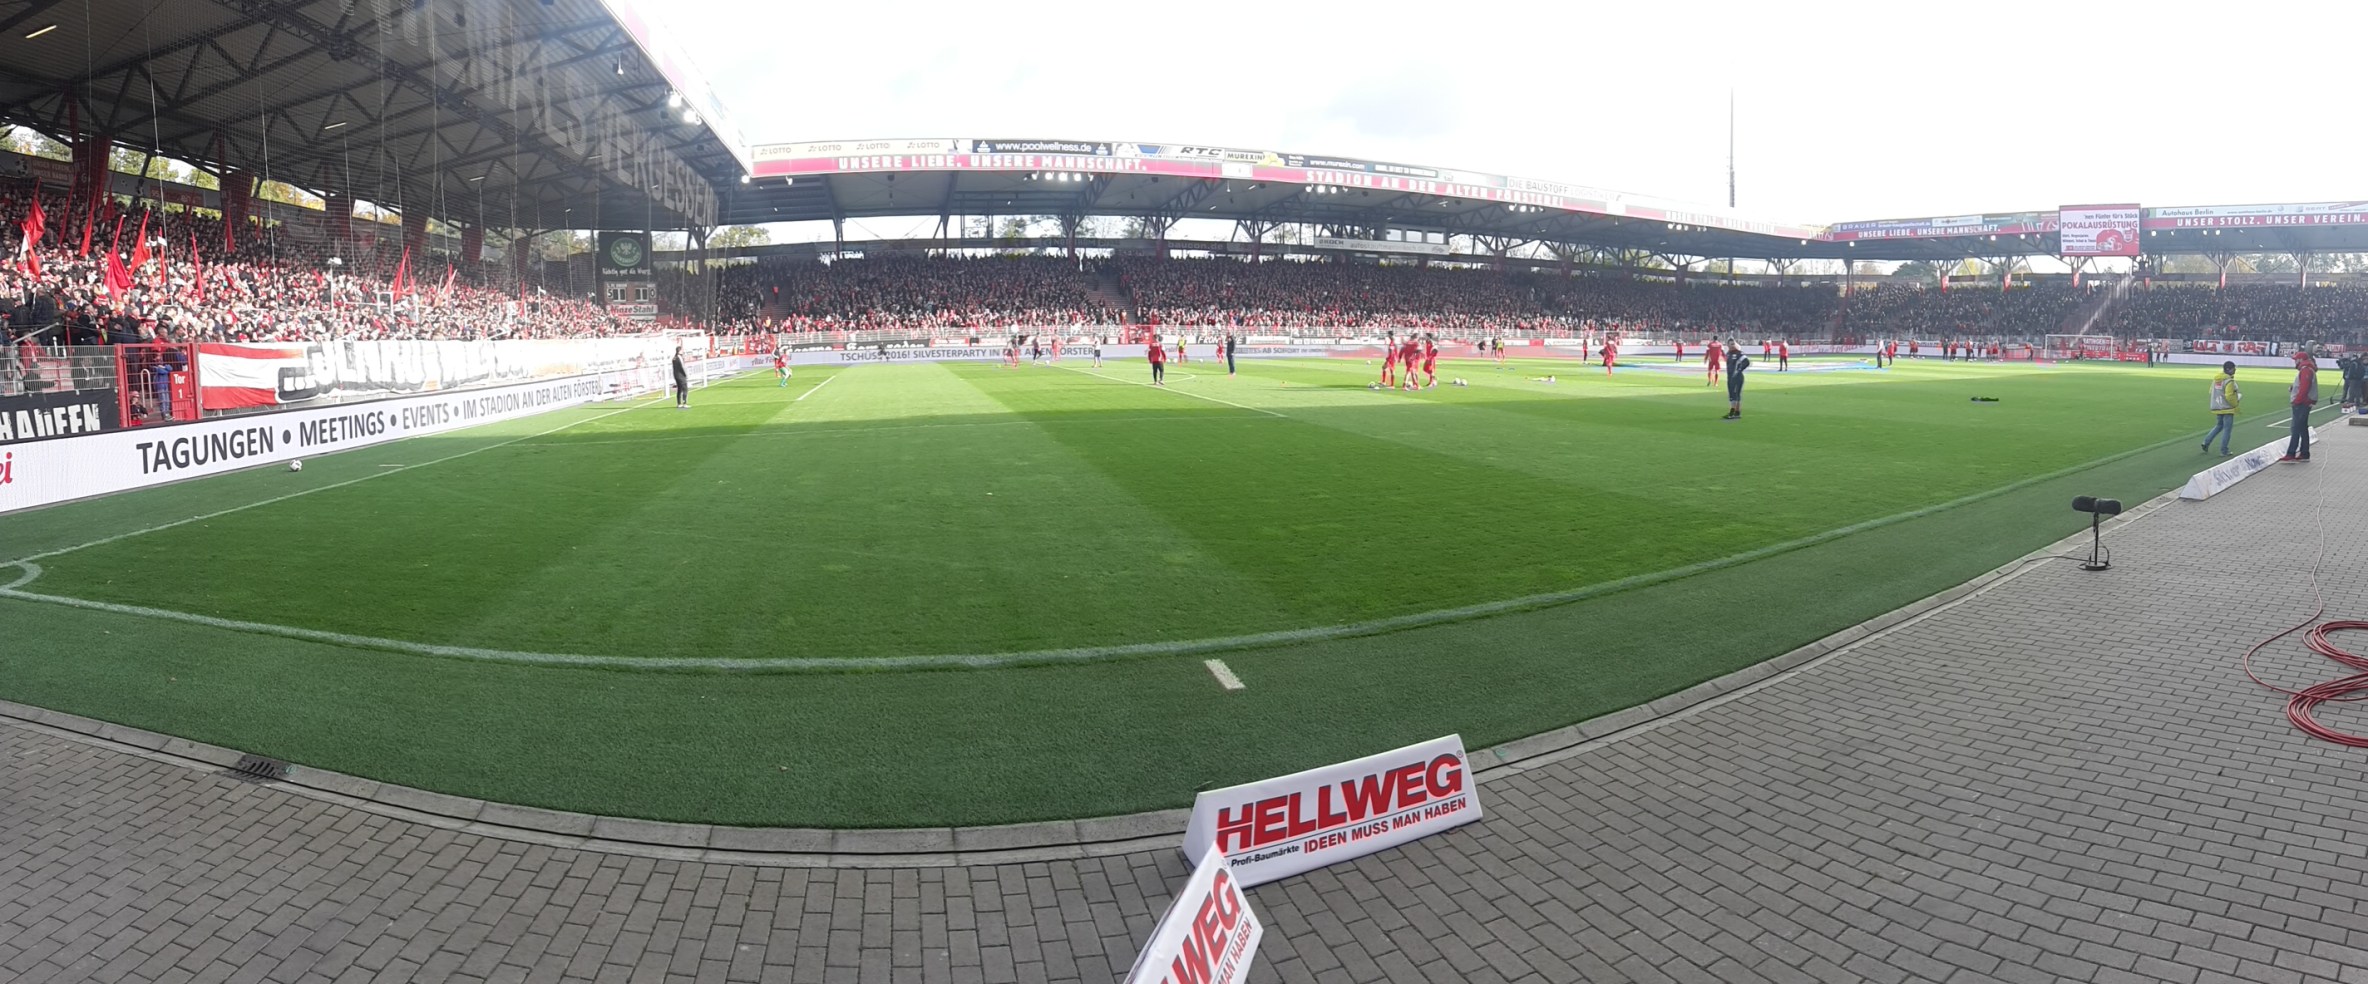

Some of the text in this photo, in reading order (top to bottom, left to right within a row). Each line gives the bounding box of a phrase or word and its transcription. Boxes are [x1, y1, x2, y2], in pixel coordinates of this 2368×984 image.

[866, 142, 890, 150] LOTTO
[995, 142, 1092, 153] www.poolwellness.de
[1181, 146, 1222, 156] RTC
[1227, 152, 1265, 161] MUREXIN
[839, 155, 902, 170] UNSERE
[970, 155, 1034, 168] UNSERE
[1042, 155, 1148, 171] MANNSCHAFT.
[1307, 170, 1372, 187] STADION
[1381, 177, 1401, 189] AN
[1409, 179, 1436, 193] DER
[1446, 184, 1488, 199] ALTEN
[1496, 188, 1564, 207] FÖRSTEREI
[1509, 178, 1523, 189] DIE
[1526, 180, 1569, 195] BAUSTOFF
[2162, 208, 2214, 217] Autohaus Berlin
[1842, 222, 1877, 231] BRAUER
[2062, 219, 2138, 230] POKALAUSRÜSTUNG
[2177, 218, 2214, 227] UNSER
[2266, 215, 2306, 224] UNSER
[1858, 229, 1886, 239] UNSERE
[1917, 227, 1945, 236] UNSERE
[913, 348, 986, 360] SILVESTERPARTY
[989, 349, 999, 358] IN
[174, 373, 185, 385] Tor
[178, 389, 183, 399] 1
[136, 426, 274, 475] TAGUNGEN
[299, 410, 385, 447] MEETINGS
[402, 402, 450, 430] EVENTS
[463, 398, 477, 420] IM
[480, 392, 520, 416] STADION
[522, 390, 534, 407] AN
[536, 388, 551, 406] DER
[552, 383, 572, 403] ALTEN
[1215, 753, 1463, 853] HELLWEG
[1304, 797, 1467, 854] IDEEN MUSS MAN HABEN
[1231, 844, 1300, 868] Profi-Baumärkte
[1160, 867, 1242, 984] WEG
[1230, 916, 1253, 965] HABEN
